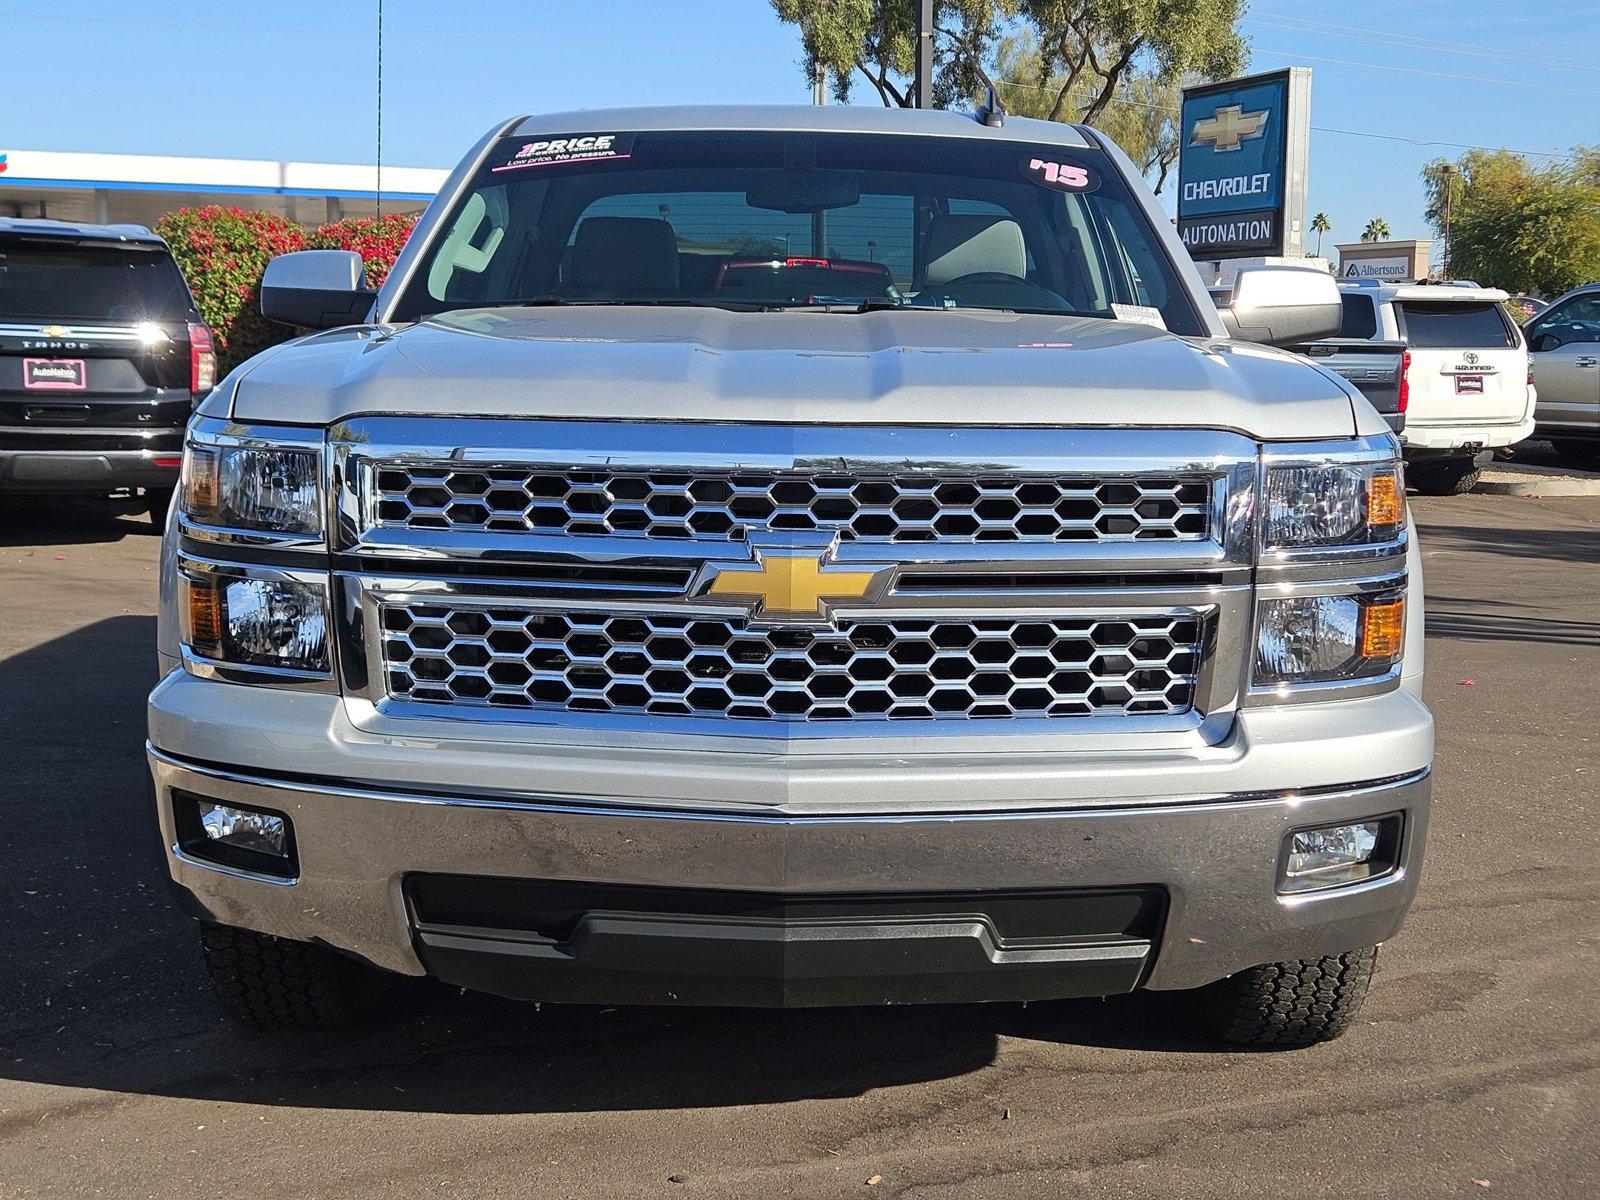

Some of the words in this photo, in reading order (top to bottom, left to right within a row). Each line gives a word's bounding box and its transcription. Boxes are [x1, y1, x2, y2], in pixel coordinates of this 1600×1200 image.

[517, 135, 616, 155] 1PRICE
[1030, 159, 1088, 187] '15
[1184, 173, 1270, 200] CHEVROLET
[1182, 220, 1270, 245] AUTONATION
[1361, 264, 1405, 276] Albertsons
[33, 367, 77, 379] AutoNation
